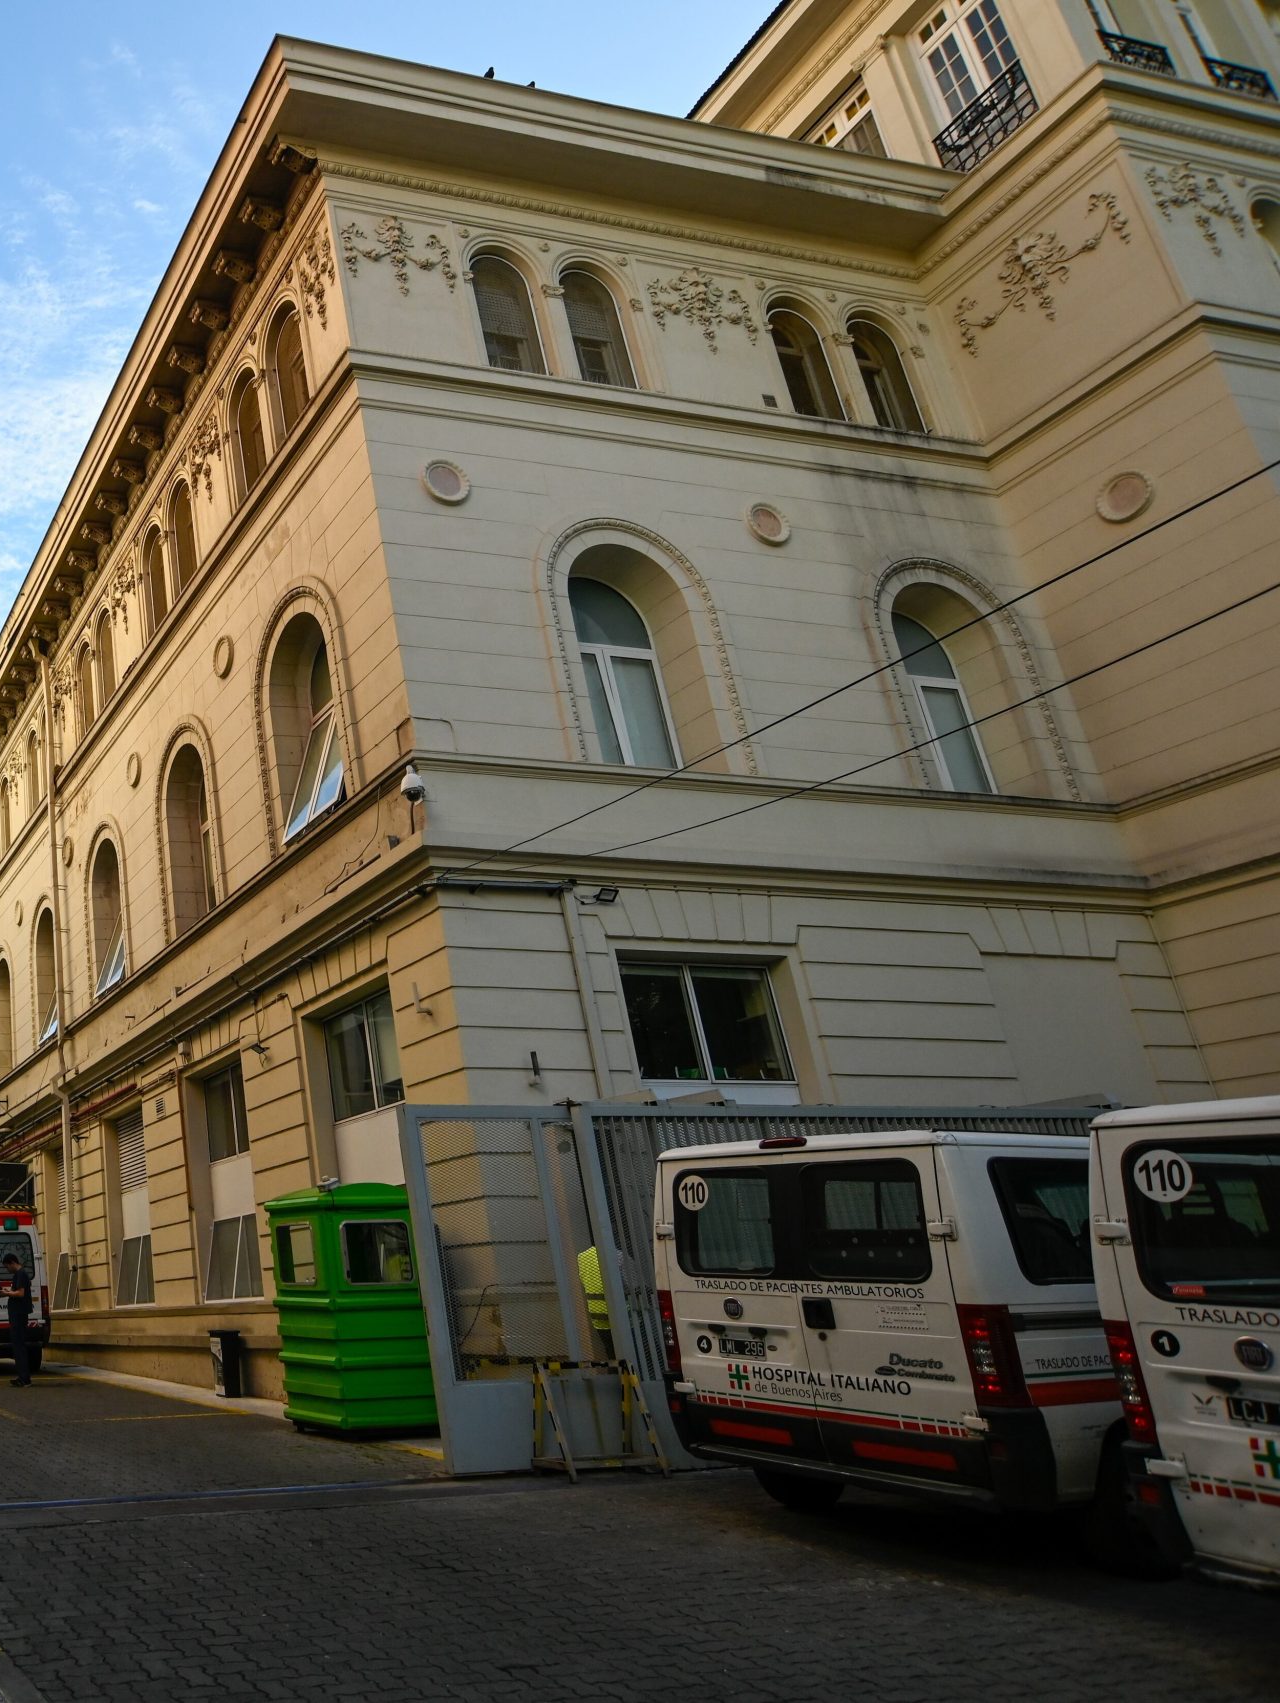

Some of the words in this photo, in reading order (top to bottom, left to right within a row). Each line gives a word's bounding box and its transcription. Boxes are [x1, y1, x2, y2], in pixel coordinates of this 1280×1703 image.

[1138, 1159, 1186, 1192] 110
[681, 1182, 706, 1204] 110
[695, 1280, 747, 1291] TRASLADO
[749, 1281, 764, 1292] DE
[766, 1282, 823, 1294] PACIENTES
[826, 1284, 925, 1299] AMBULATORIOS
[1175, 1306, 1280, 1327] TRASLADO
[700, 1339, 708, 1349] 4
[720, 1339, 739, 1353] LML
[744, 1341, 765, 1356] 296
[1159, 1335, 1171, 1352] 1
[888, 1352, 943, 1369] Ducato
[1035, 1356, 1080, 1370] TRASLADO
[1081, 1355, 1093, 1367] DE
[753, 1366, 825, 1387] HOSPITAL
[831, 1374, 911, 1395] ITALIANO
[897, 1368, 956, 1382] Combinato
[754, 1381, 768, 1393] de
[771, 1383, 811, 1399] Buenos
[813, 1388, 843, 1402] Aires
[1228, 1396, 1268, 1423] LCJ
